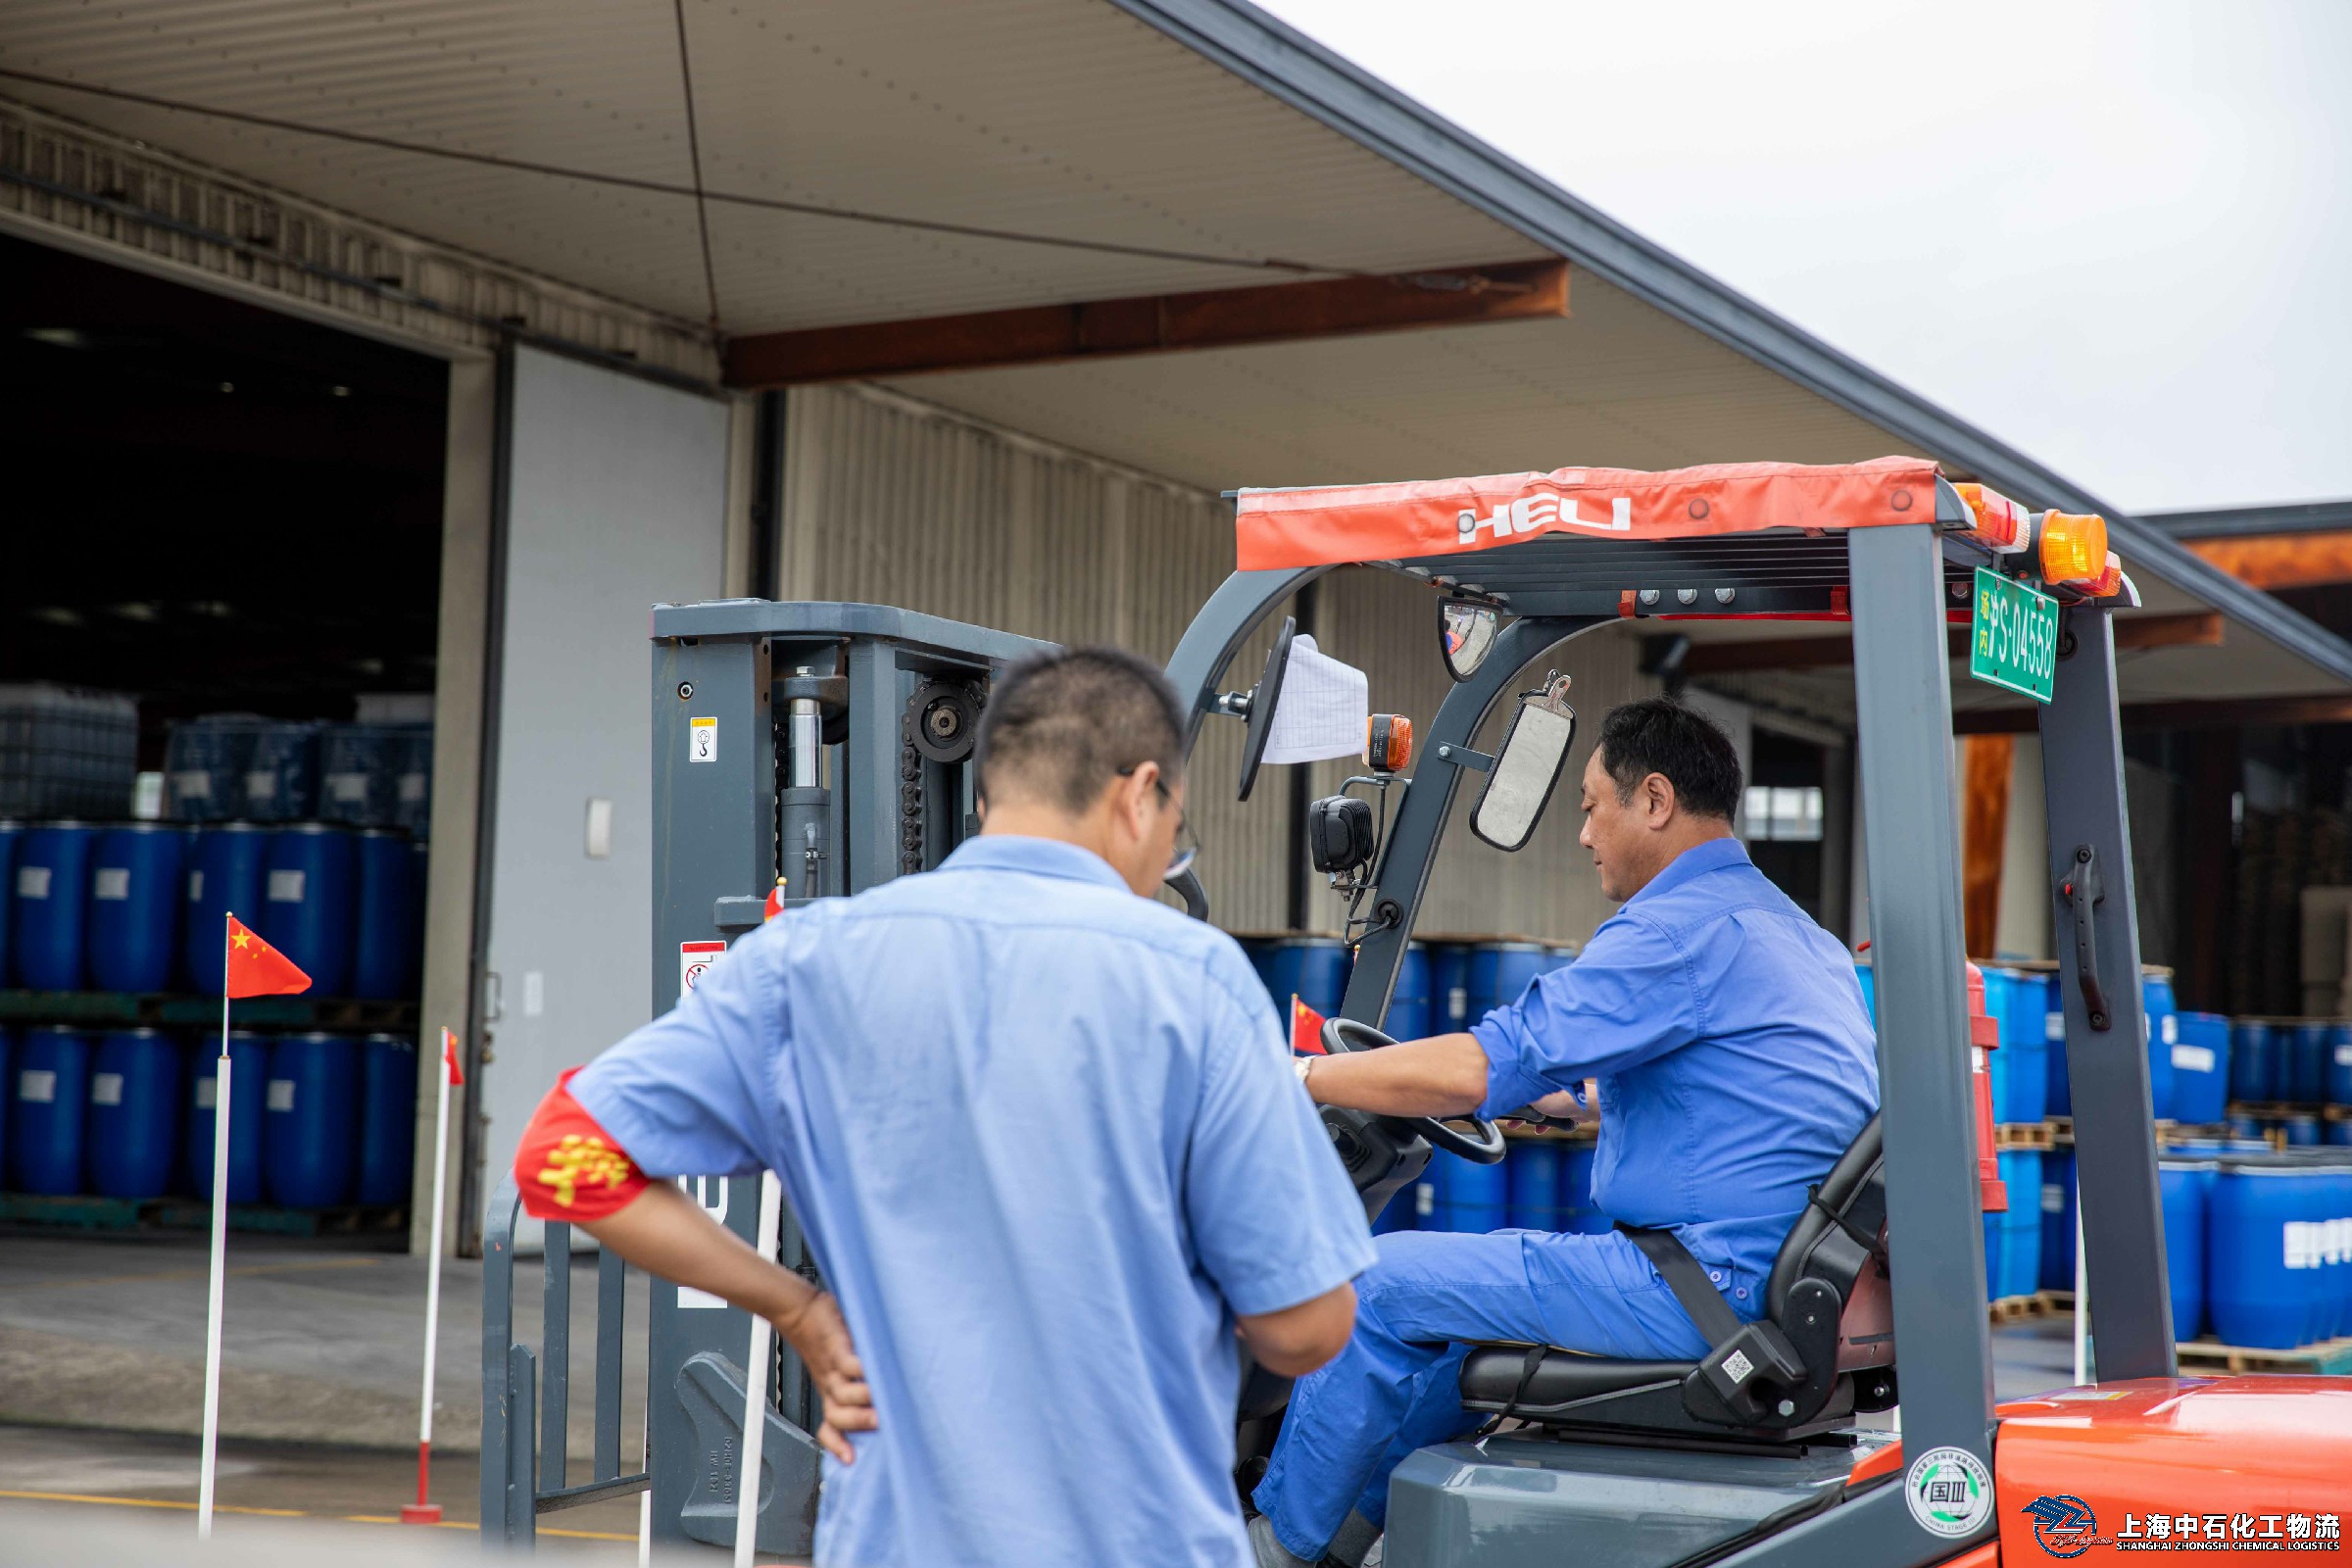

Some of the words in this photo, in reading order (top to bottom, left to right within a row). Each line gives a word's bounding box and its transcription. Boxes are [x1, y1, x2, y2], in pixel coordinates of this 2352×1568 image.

[1456, 492, 1631, 545] HELI
[1925, 1514, 1944, 1530] CHINA
[1946, 1521, 1967, 1531] STAGE
